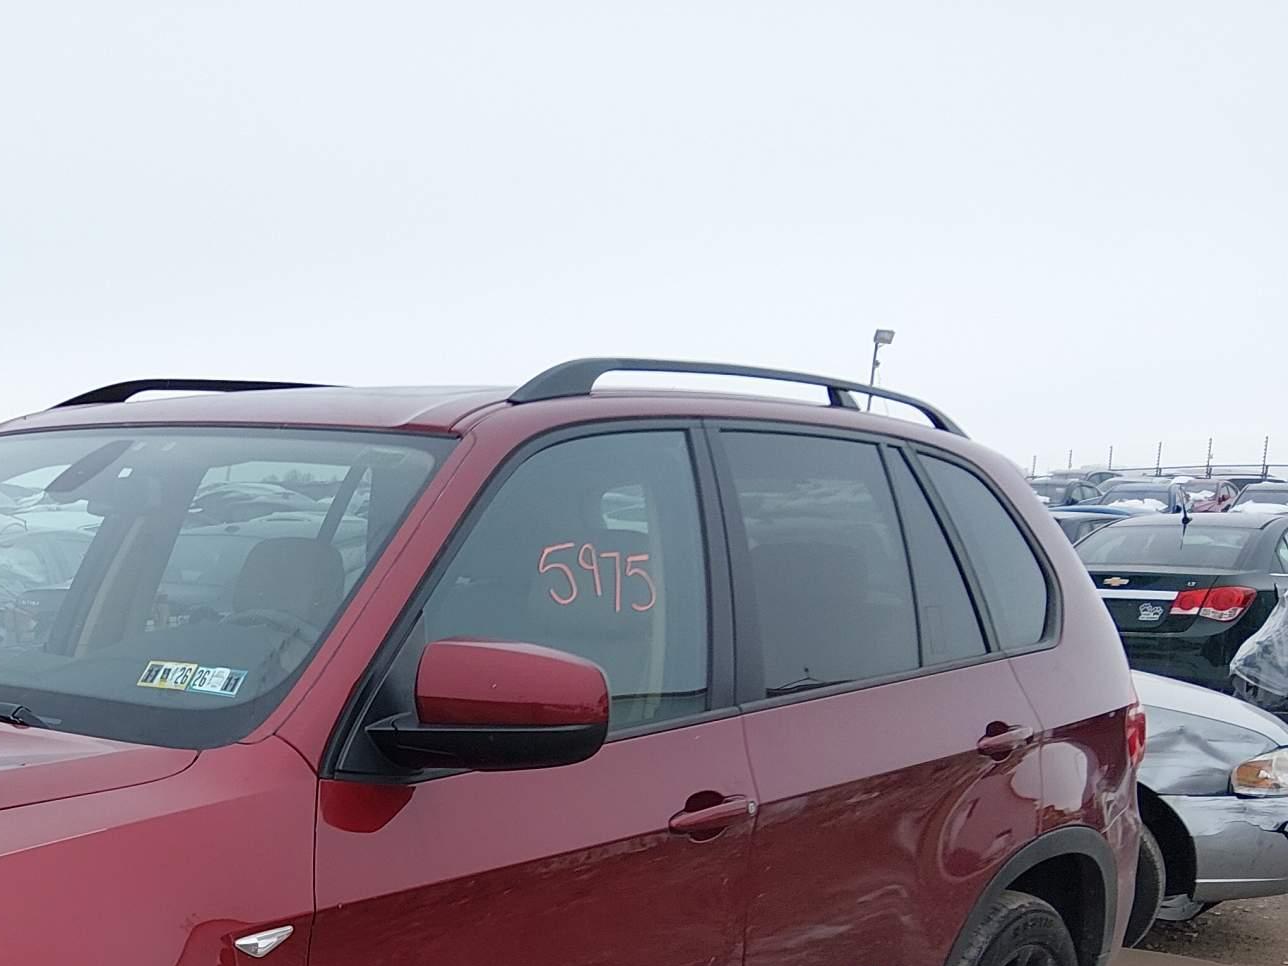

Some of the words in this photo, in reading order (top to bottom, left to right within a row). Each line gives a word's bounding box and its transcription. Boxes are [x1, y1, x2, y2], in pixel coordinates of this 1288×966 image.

[538, 542, 657, 613] 5975
[174, 666, 192, 685] 26
[192, 669, 210, 688] 26
